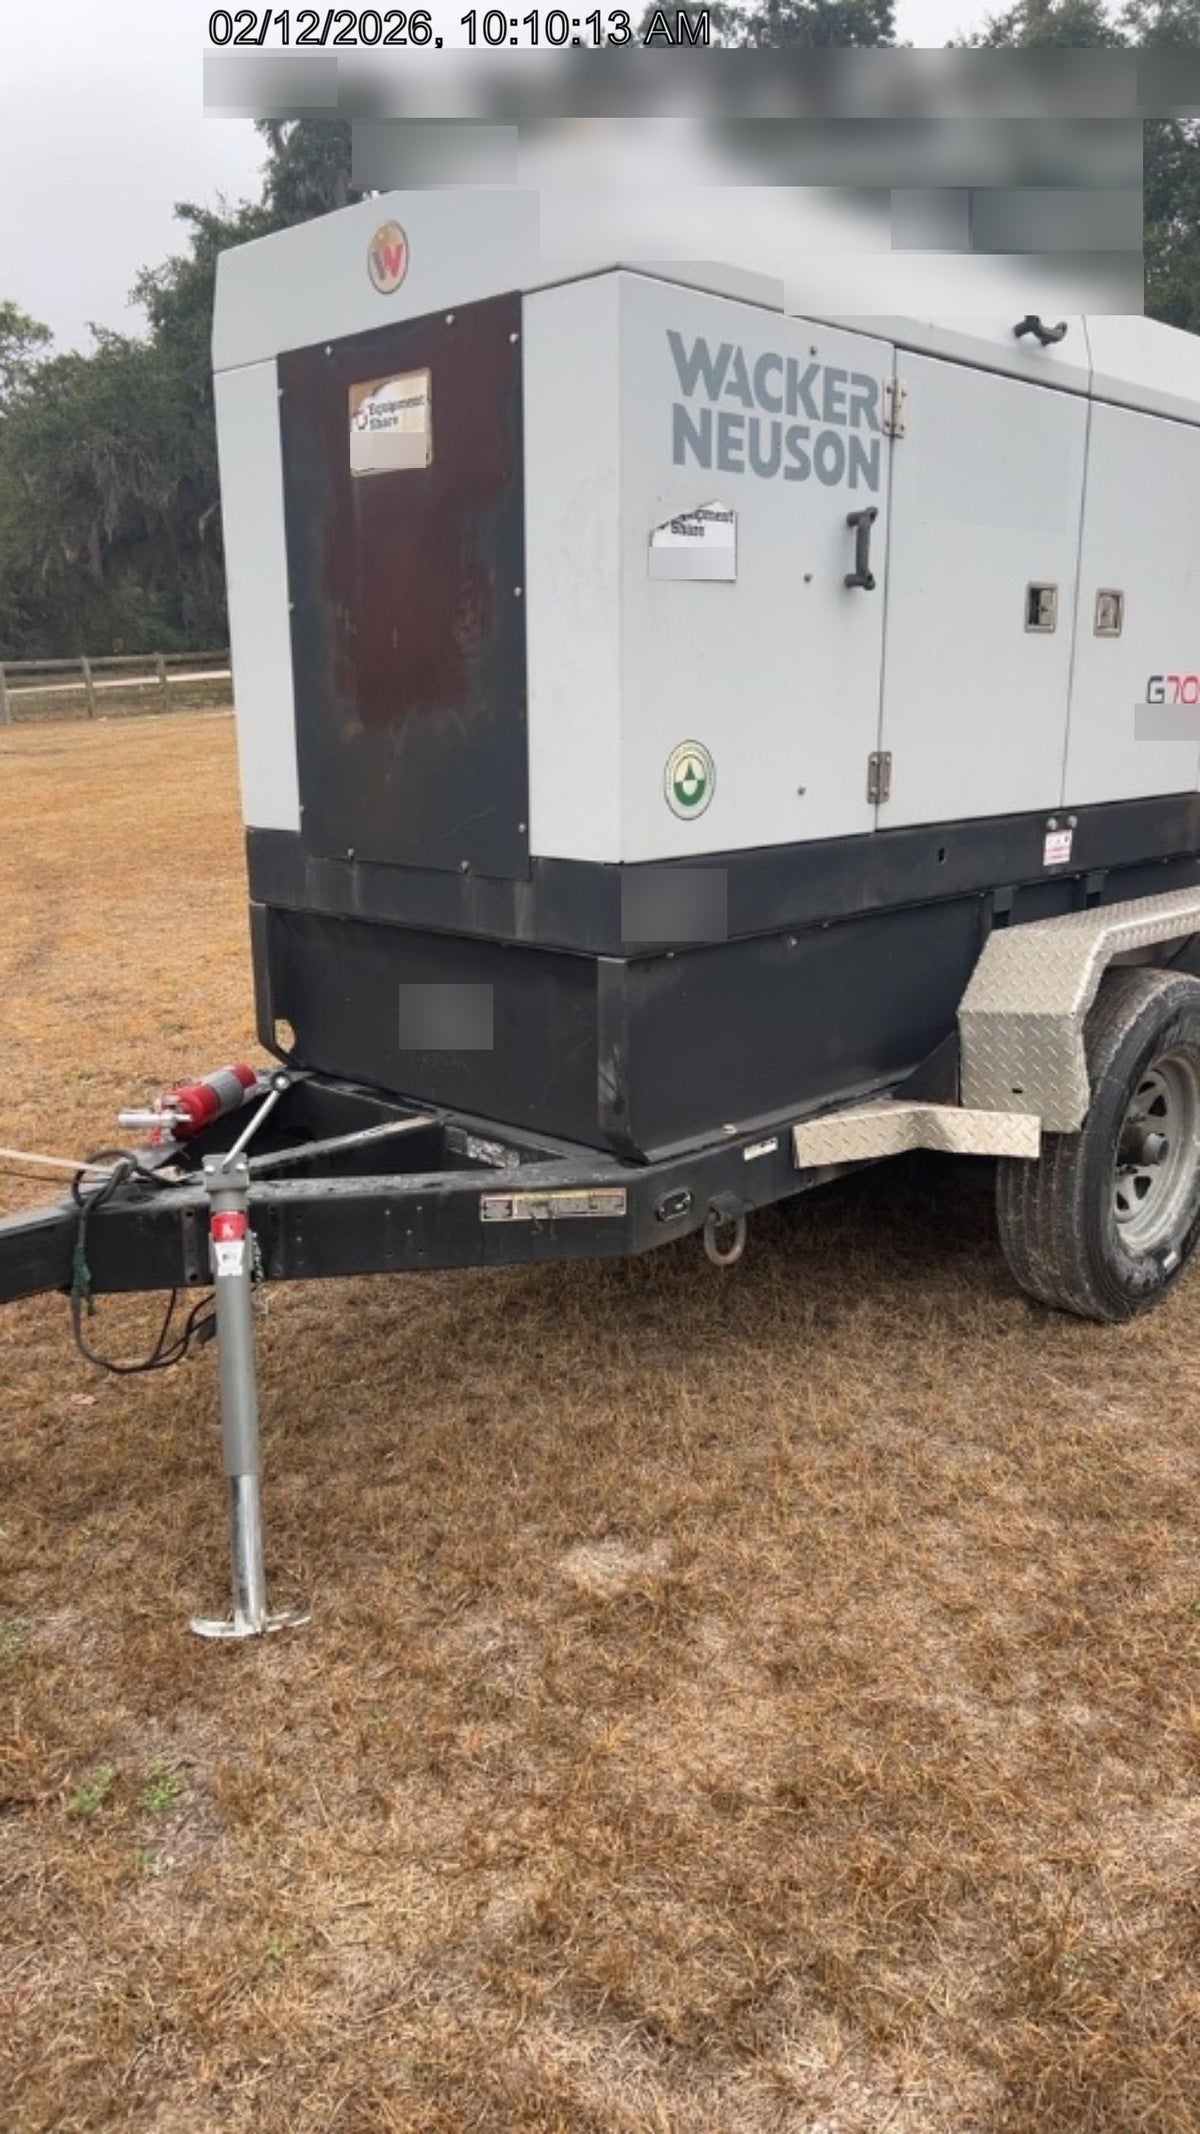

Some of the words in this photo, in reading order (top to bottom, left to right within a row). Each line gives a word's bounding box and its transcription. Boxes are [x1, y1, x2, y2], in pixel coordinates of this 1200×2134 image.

[665, 328, 883, 432] WACKER
[672, 402, 881, 492] NEUSON
[1146, 674, 1199, 704] G70
